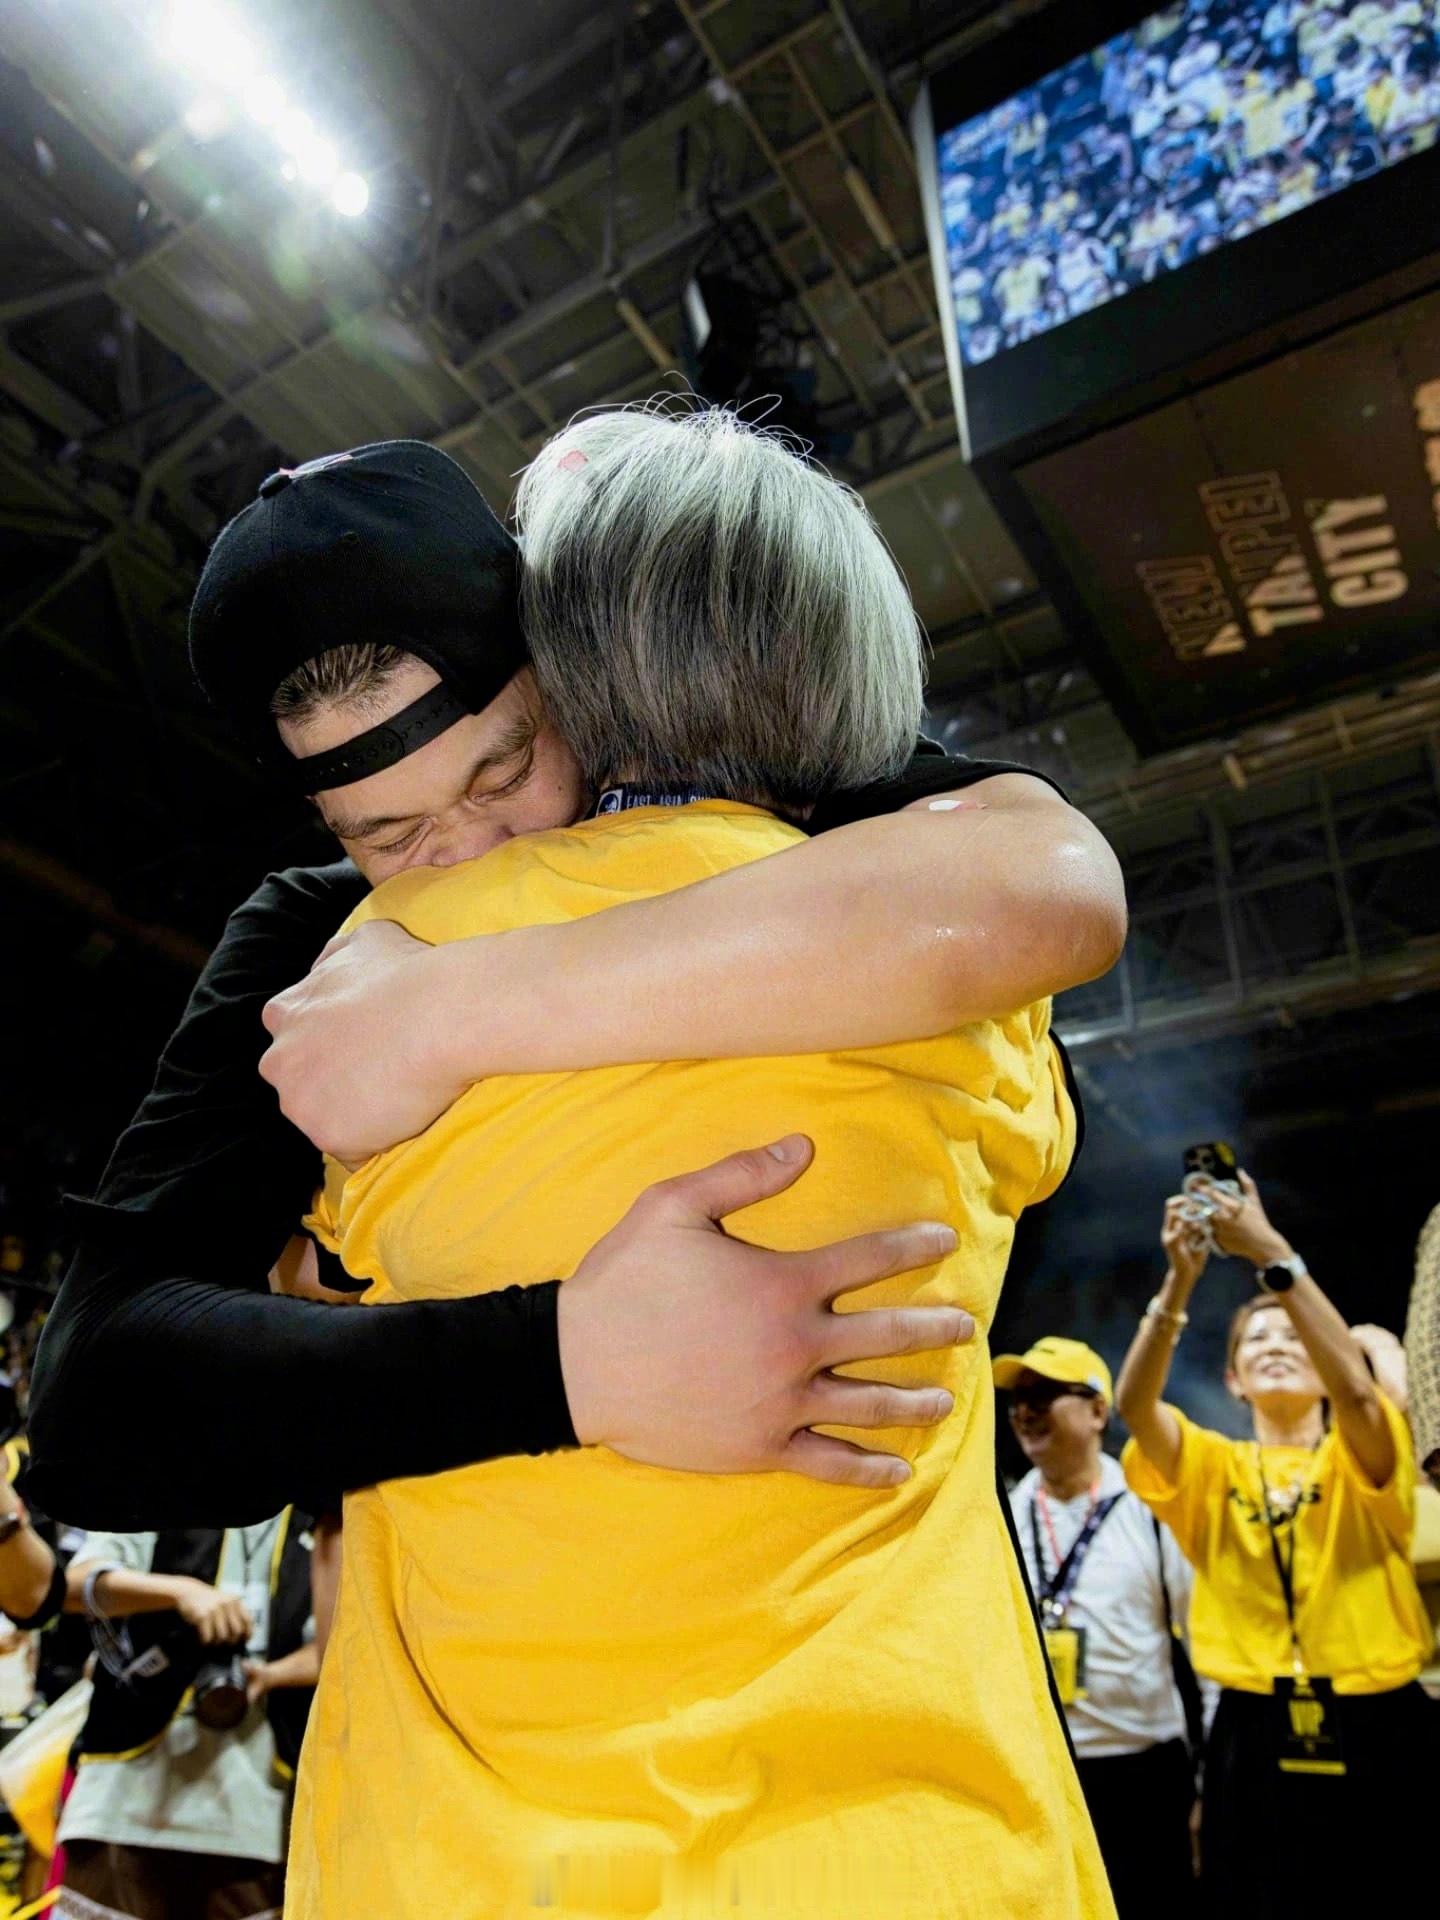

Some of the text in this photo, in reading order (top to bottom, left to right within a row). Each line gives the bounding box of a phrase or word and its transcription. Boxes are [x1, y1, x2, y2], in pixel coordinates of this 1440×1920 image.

[1198, 470, 1326, 638] TAIPEI
[1303, 494, 1409, 609] CITY
[1136, 555, 1247, 662] NEW
[626, 794, 651, 809] EAST
[659, 794, 682, 807] ASIA
